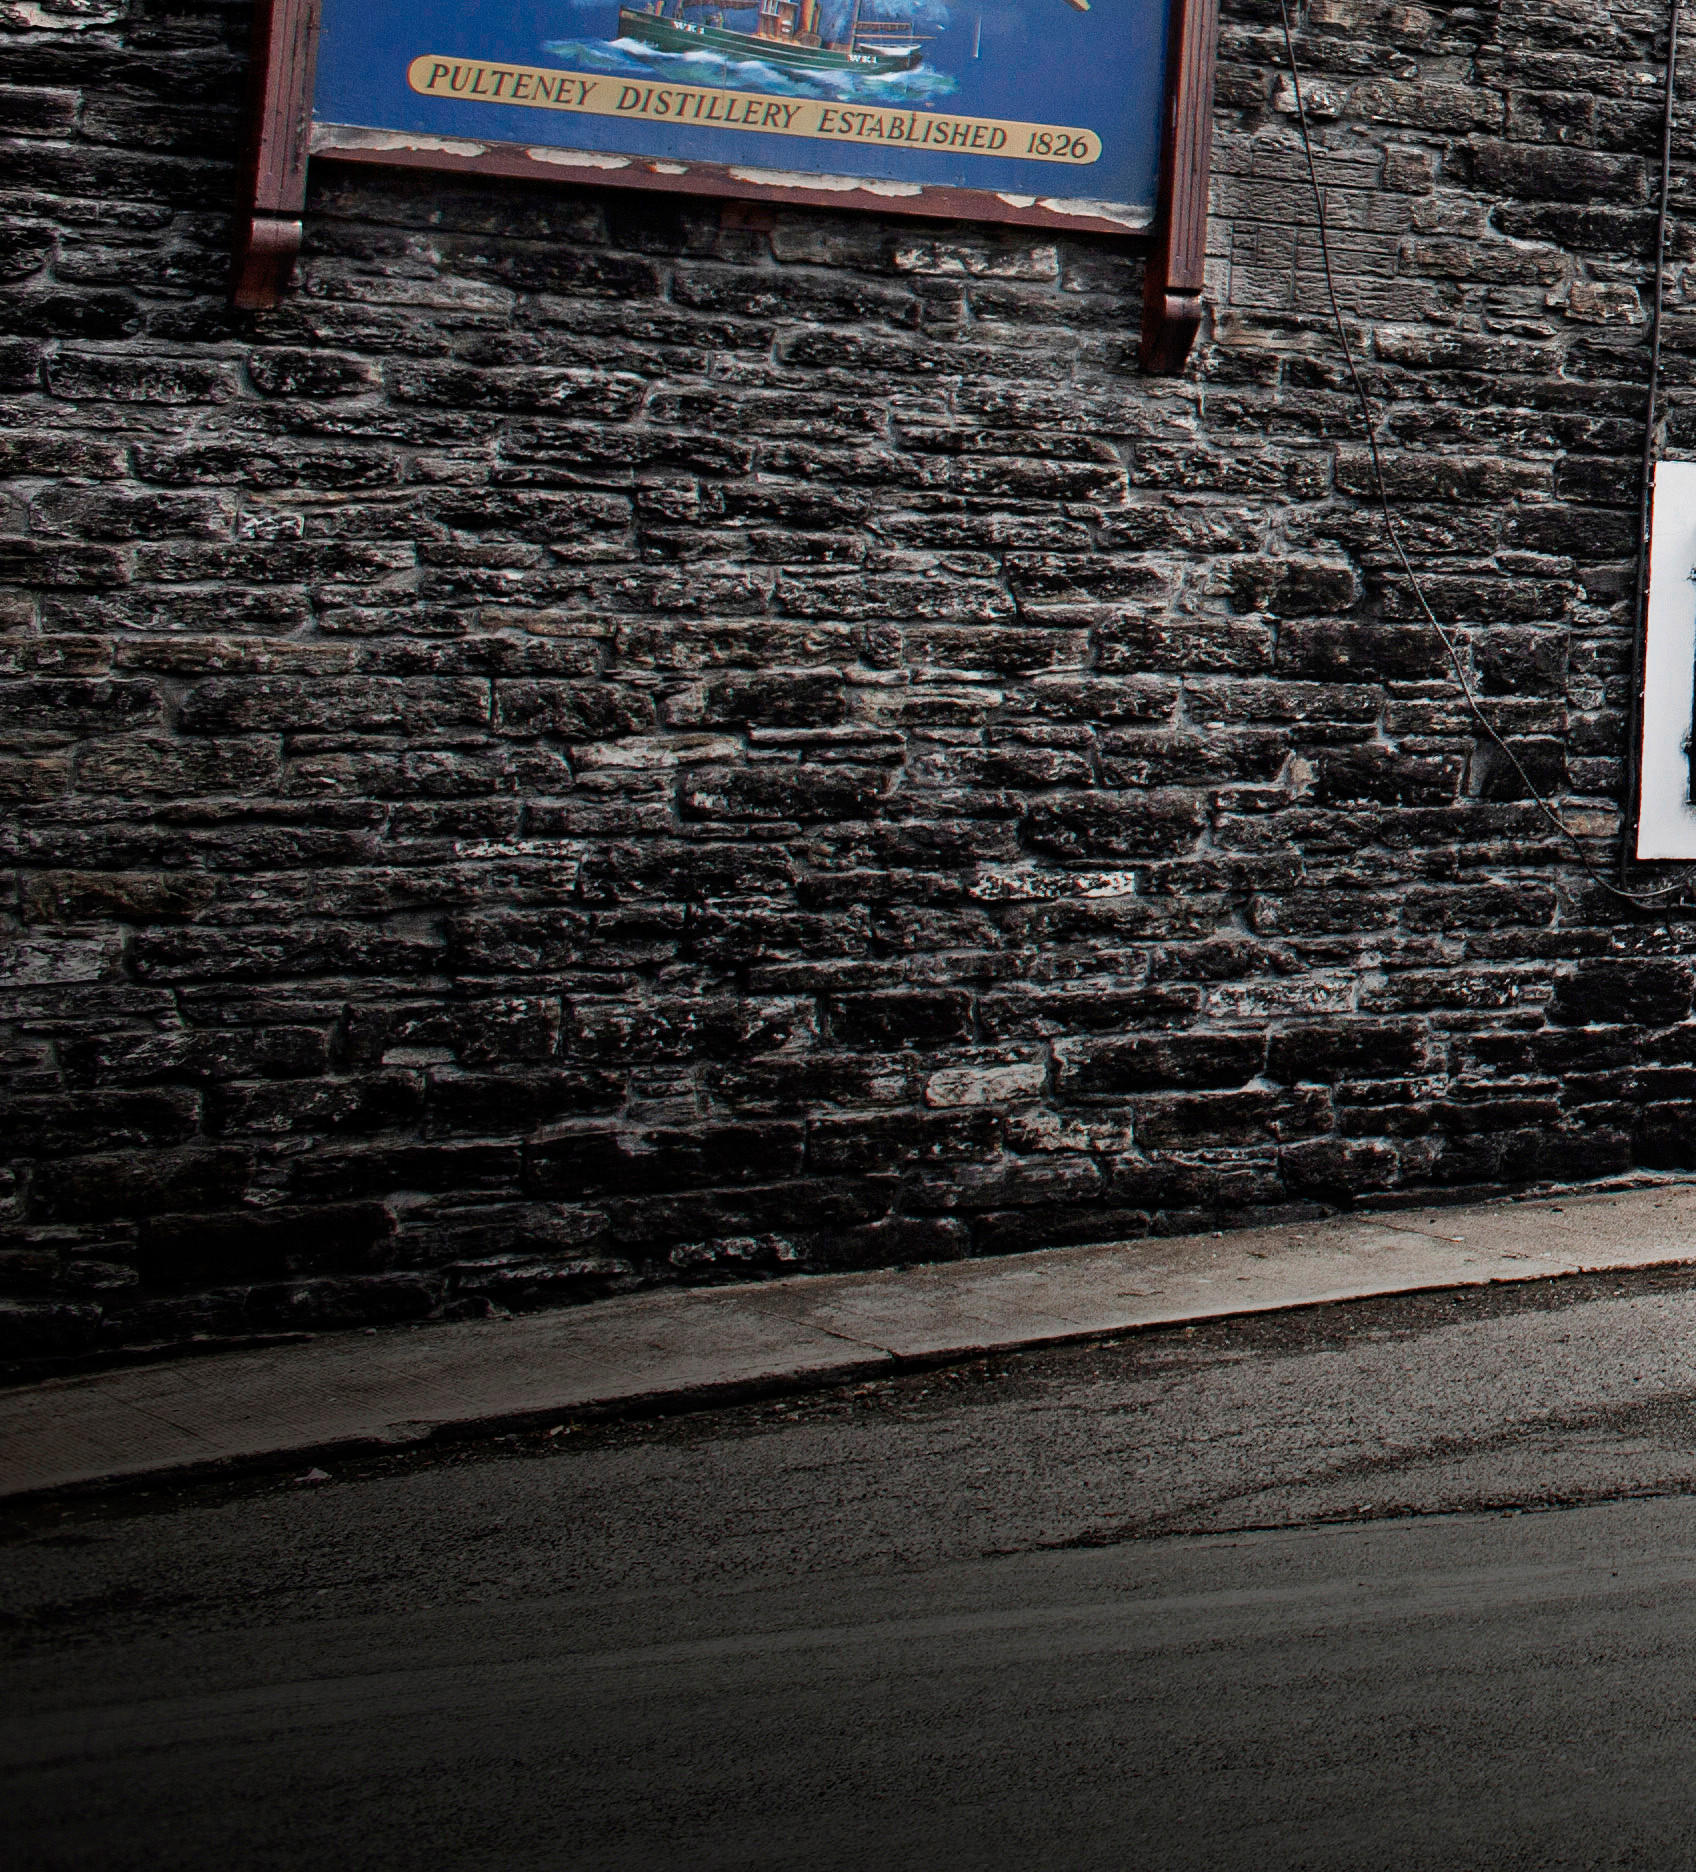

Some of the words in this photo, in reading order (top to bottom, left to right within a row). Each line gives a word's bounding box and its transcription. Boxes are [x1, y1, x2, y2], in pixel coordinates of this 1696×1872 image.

[427, 63, 599, 107] PULTENEY
[616, 85, 802, 129] DISTILLERY
[817, 107, 1008, 150] ESTABLISHED
[1027, 131, 1088, 160] 1826
